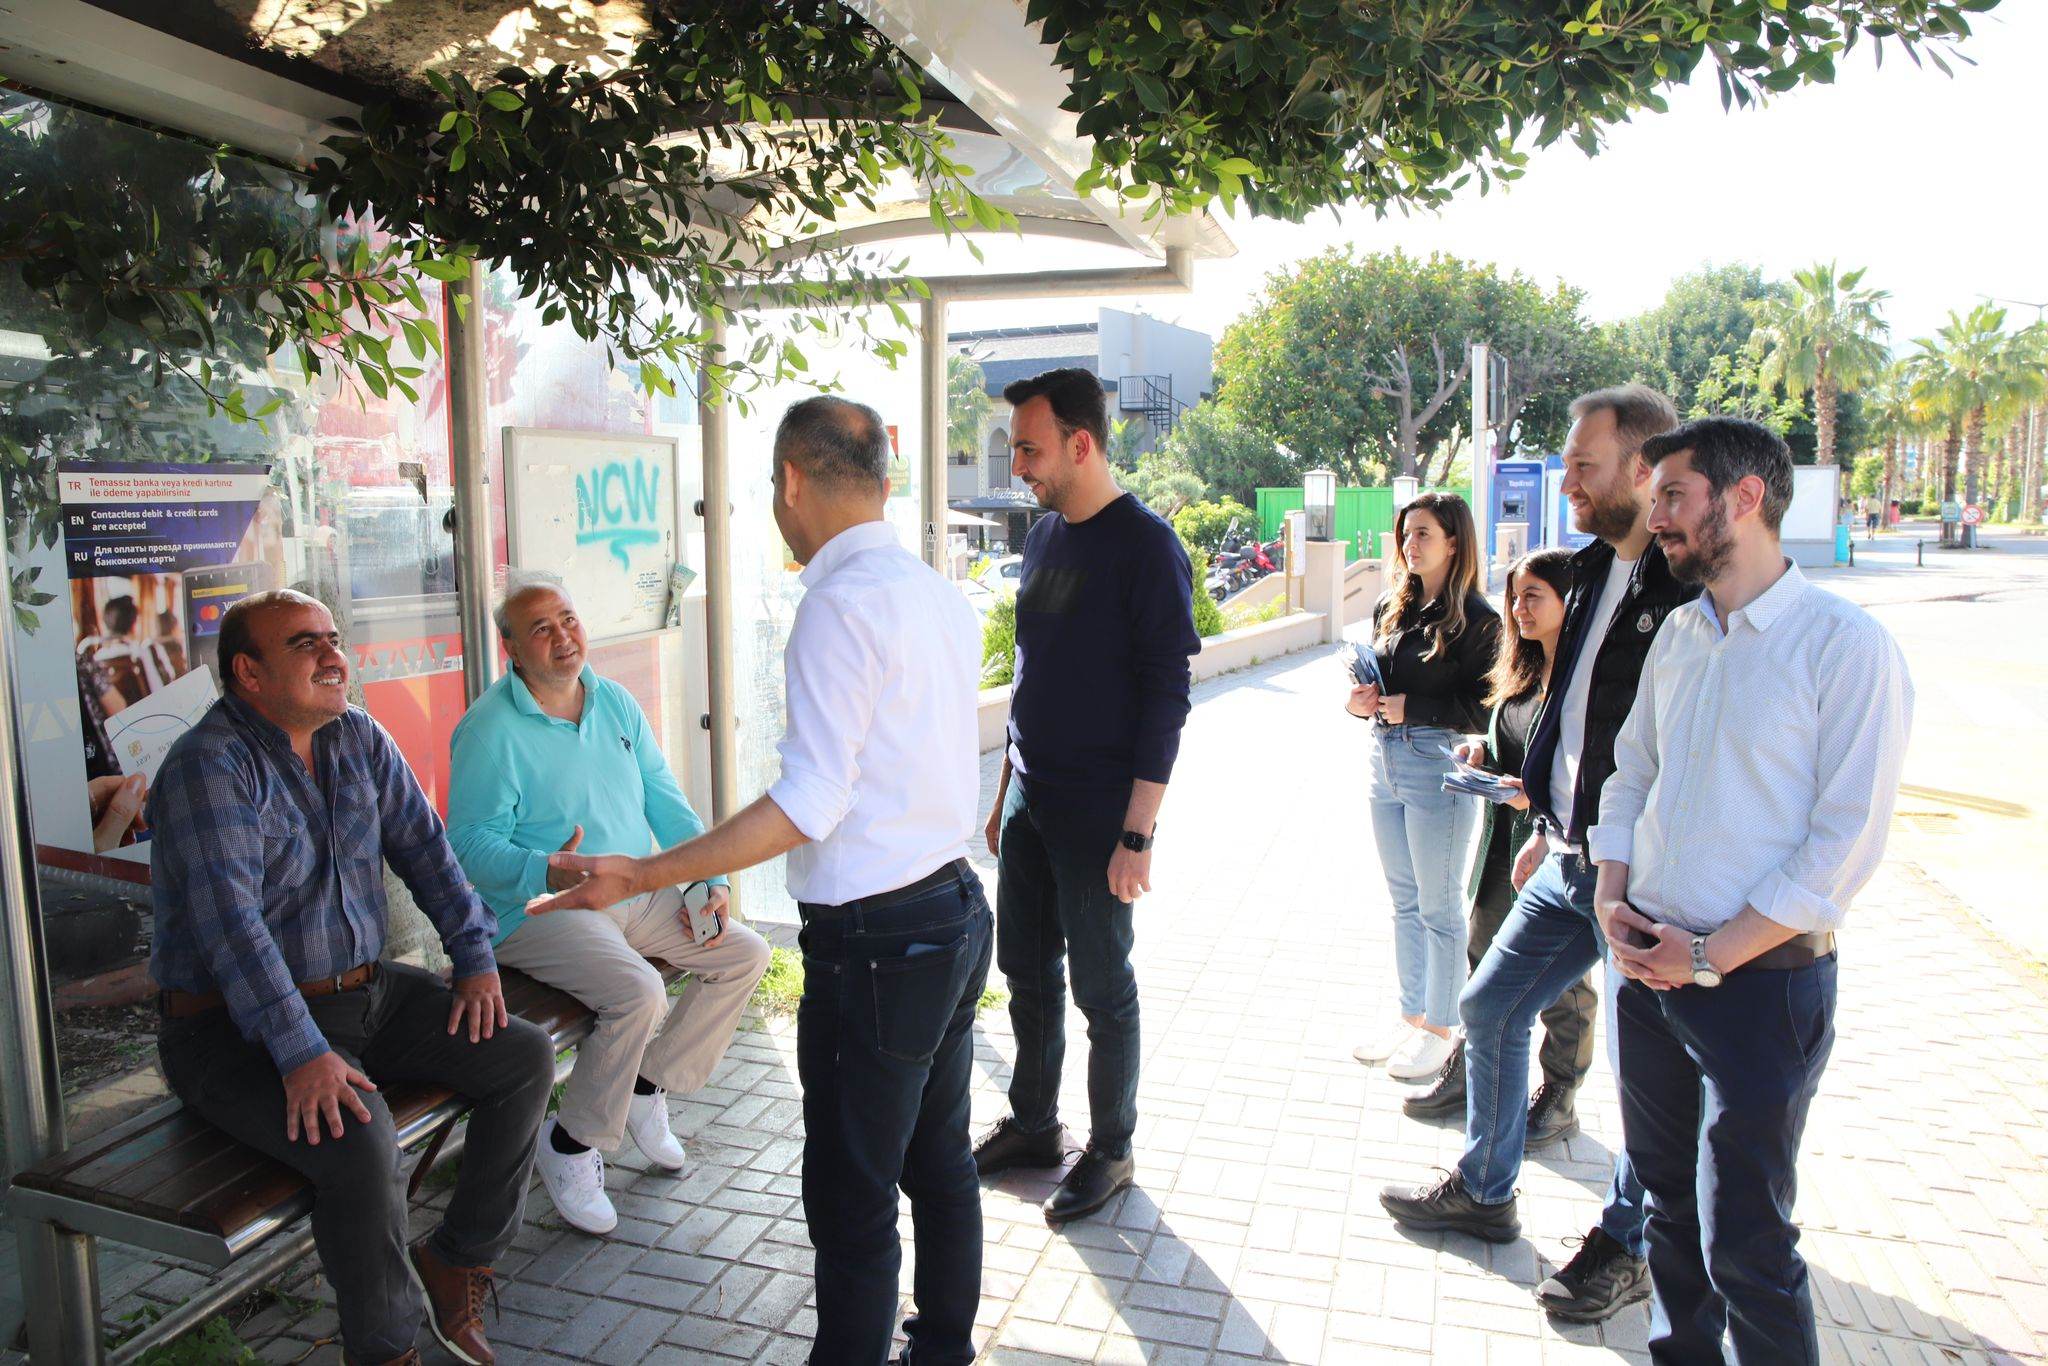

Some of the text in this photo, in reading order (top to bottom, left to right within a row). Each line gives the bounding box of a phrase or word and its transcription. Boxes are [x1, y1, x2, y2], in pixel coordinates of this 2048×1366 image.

[67, 481, 82, 491] TR
[89, 477, 233, 488] Temassız banka veya kredi kartınız
[90, 488, 191, 498] ile ödeme yapabilirsiniz
[987, 486, 1026, 501] Sultan
[91, 508, 219, 519] Contactless debit & credit cards
[70, 515, 85, 525] EN
[108, 520, 147, 532] accepted
[94, 541, 237, 557] Для оплаты проезда принимаются
[74, 552, 88, 562] RU
[95, 555, 176, 566] банковские карты
